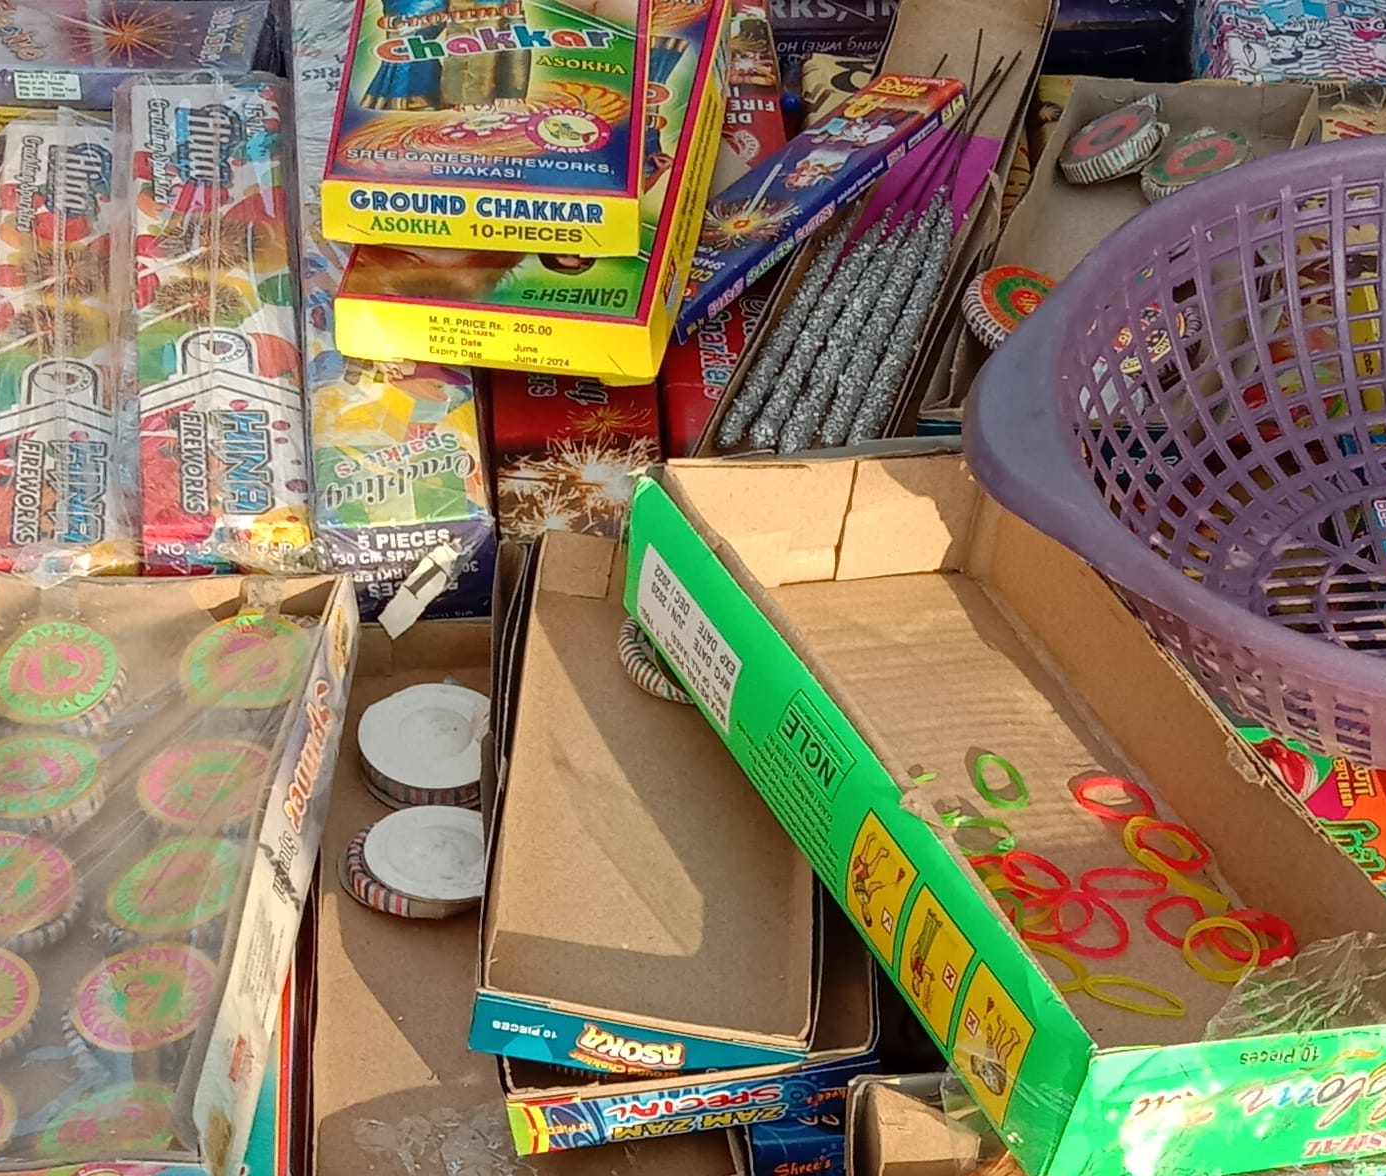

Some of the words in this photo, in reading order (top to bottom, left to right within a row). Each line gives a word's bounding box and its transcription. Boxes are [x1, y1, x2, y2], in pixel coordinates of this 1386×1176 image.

[534, 54, 627, 77] ASOKHA
[541, 107, 596, 123] TRADE
[345, 147, 402, 162] SREE
[404, 151, 486, 166] GANESH
[348, 189, 465, 218] GROUND
[472, 196, 605, 225] CHAKKAR
[370, 216, 451, 237] ASOKHA
[468, 223, 583, 243] 10-PIECES
[456, 318, 486, 328] PRICE
[513, 322, 553, 336] 205.00
[428, 345, 458, 358] Expiry
[460, 348, 483, 359] Date
[513, 354, 538, 365] June
[460, 338, 483, 348] Date
[513, 343, 539, 354] June
[181, 411, 211, 515] FIREWORKS
[216, 410, 273, 515] HINA
[15, 439, 43, 544] FIREWORKS
[47, 439, 109, 544] HINA
[357, 534, 371, 550] 5
[375, 528, 451, 549] PIECES
[694, 620, 721, 652] DATE
[778, 704, 840, 787] NCLE
[492, 1020, 541, 1036] PIECES
[543, 1029, 558, 1040] 10
[579, 1025, 685, 1066] ASOKA
[1239, 1048, 1298, 1067] Pieces
[604, 1083, 784, 1120] SPECIAL
[702, 1102, 788, 1131] ZAM
[611, 1119, 699, 1142] ZAM
